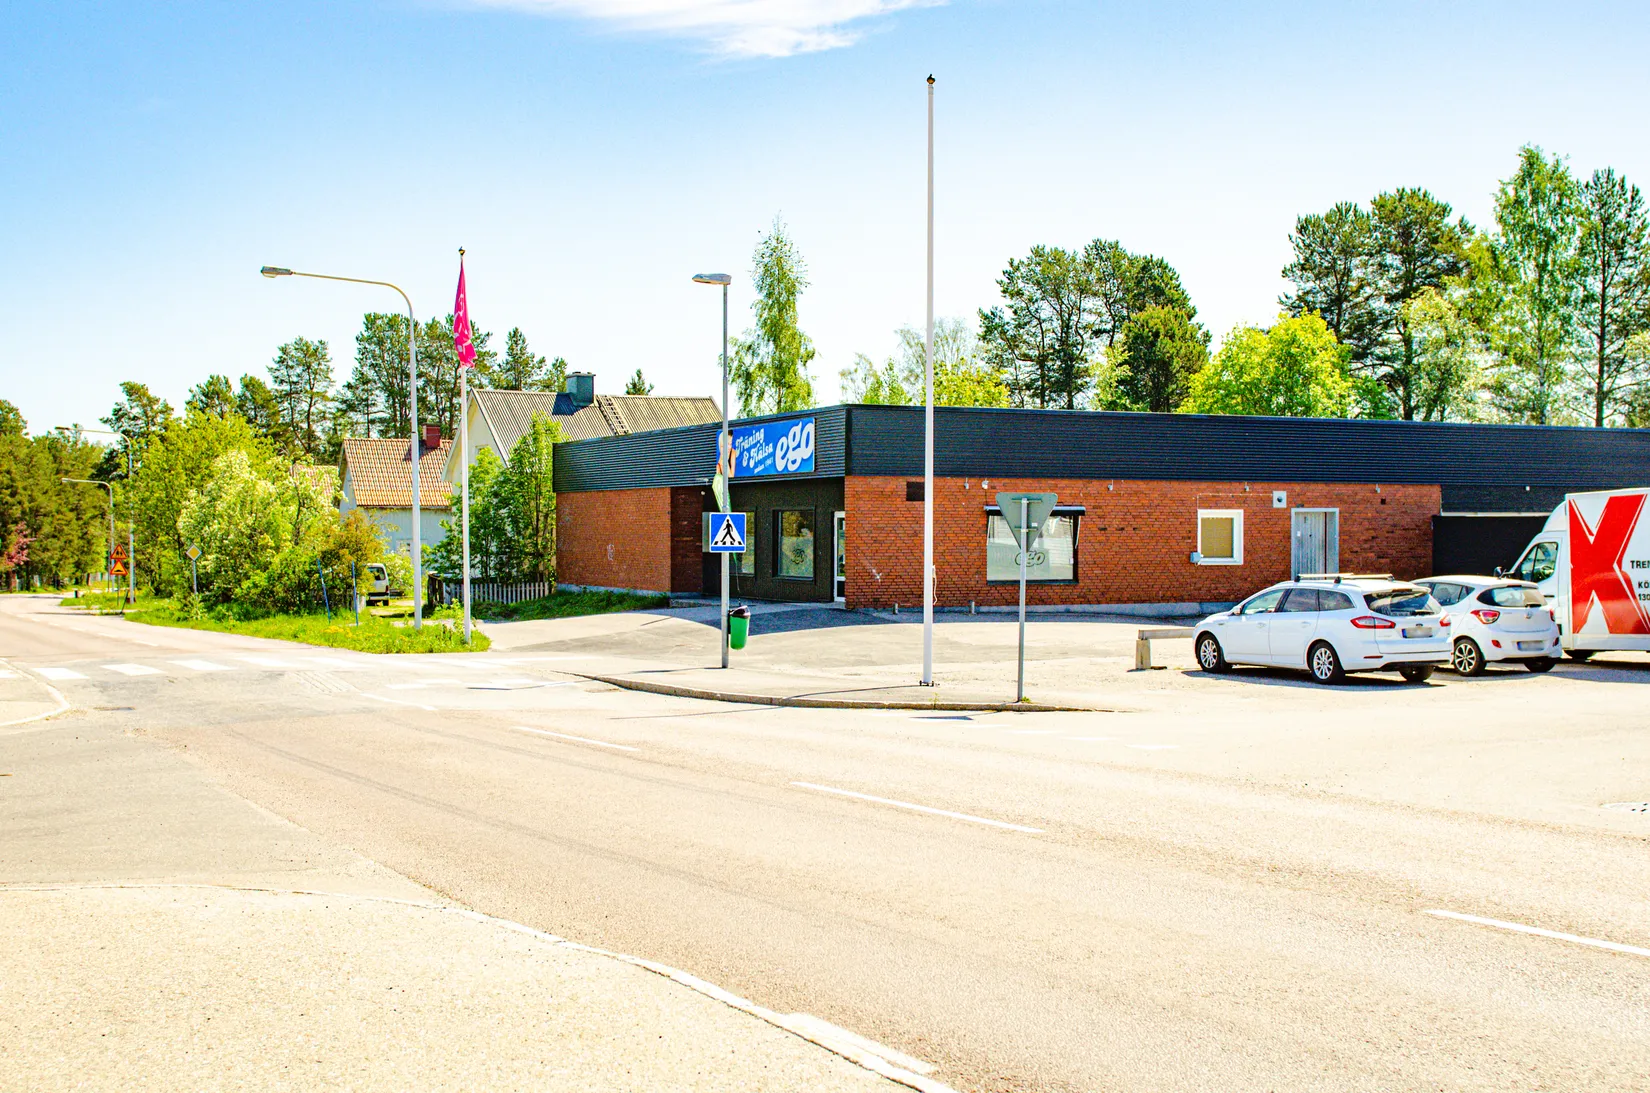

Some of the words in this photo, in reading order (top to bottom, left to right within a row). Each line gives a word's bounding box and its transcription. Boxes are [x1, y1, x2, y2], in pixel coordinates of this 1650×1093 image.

[736, 428, 764, 457] Träning
[742, 451, 749, 467] &
[750, 443, 773, 468] Hälsa
[775, 421, 815, 472] ego
